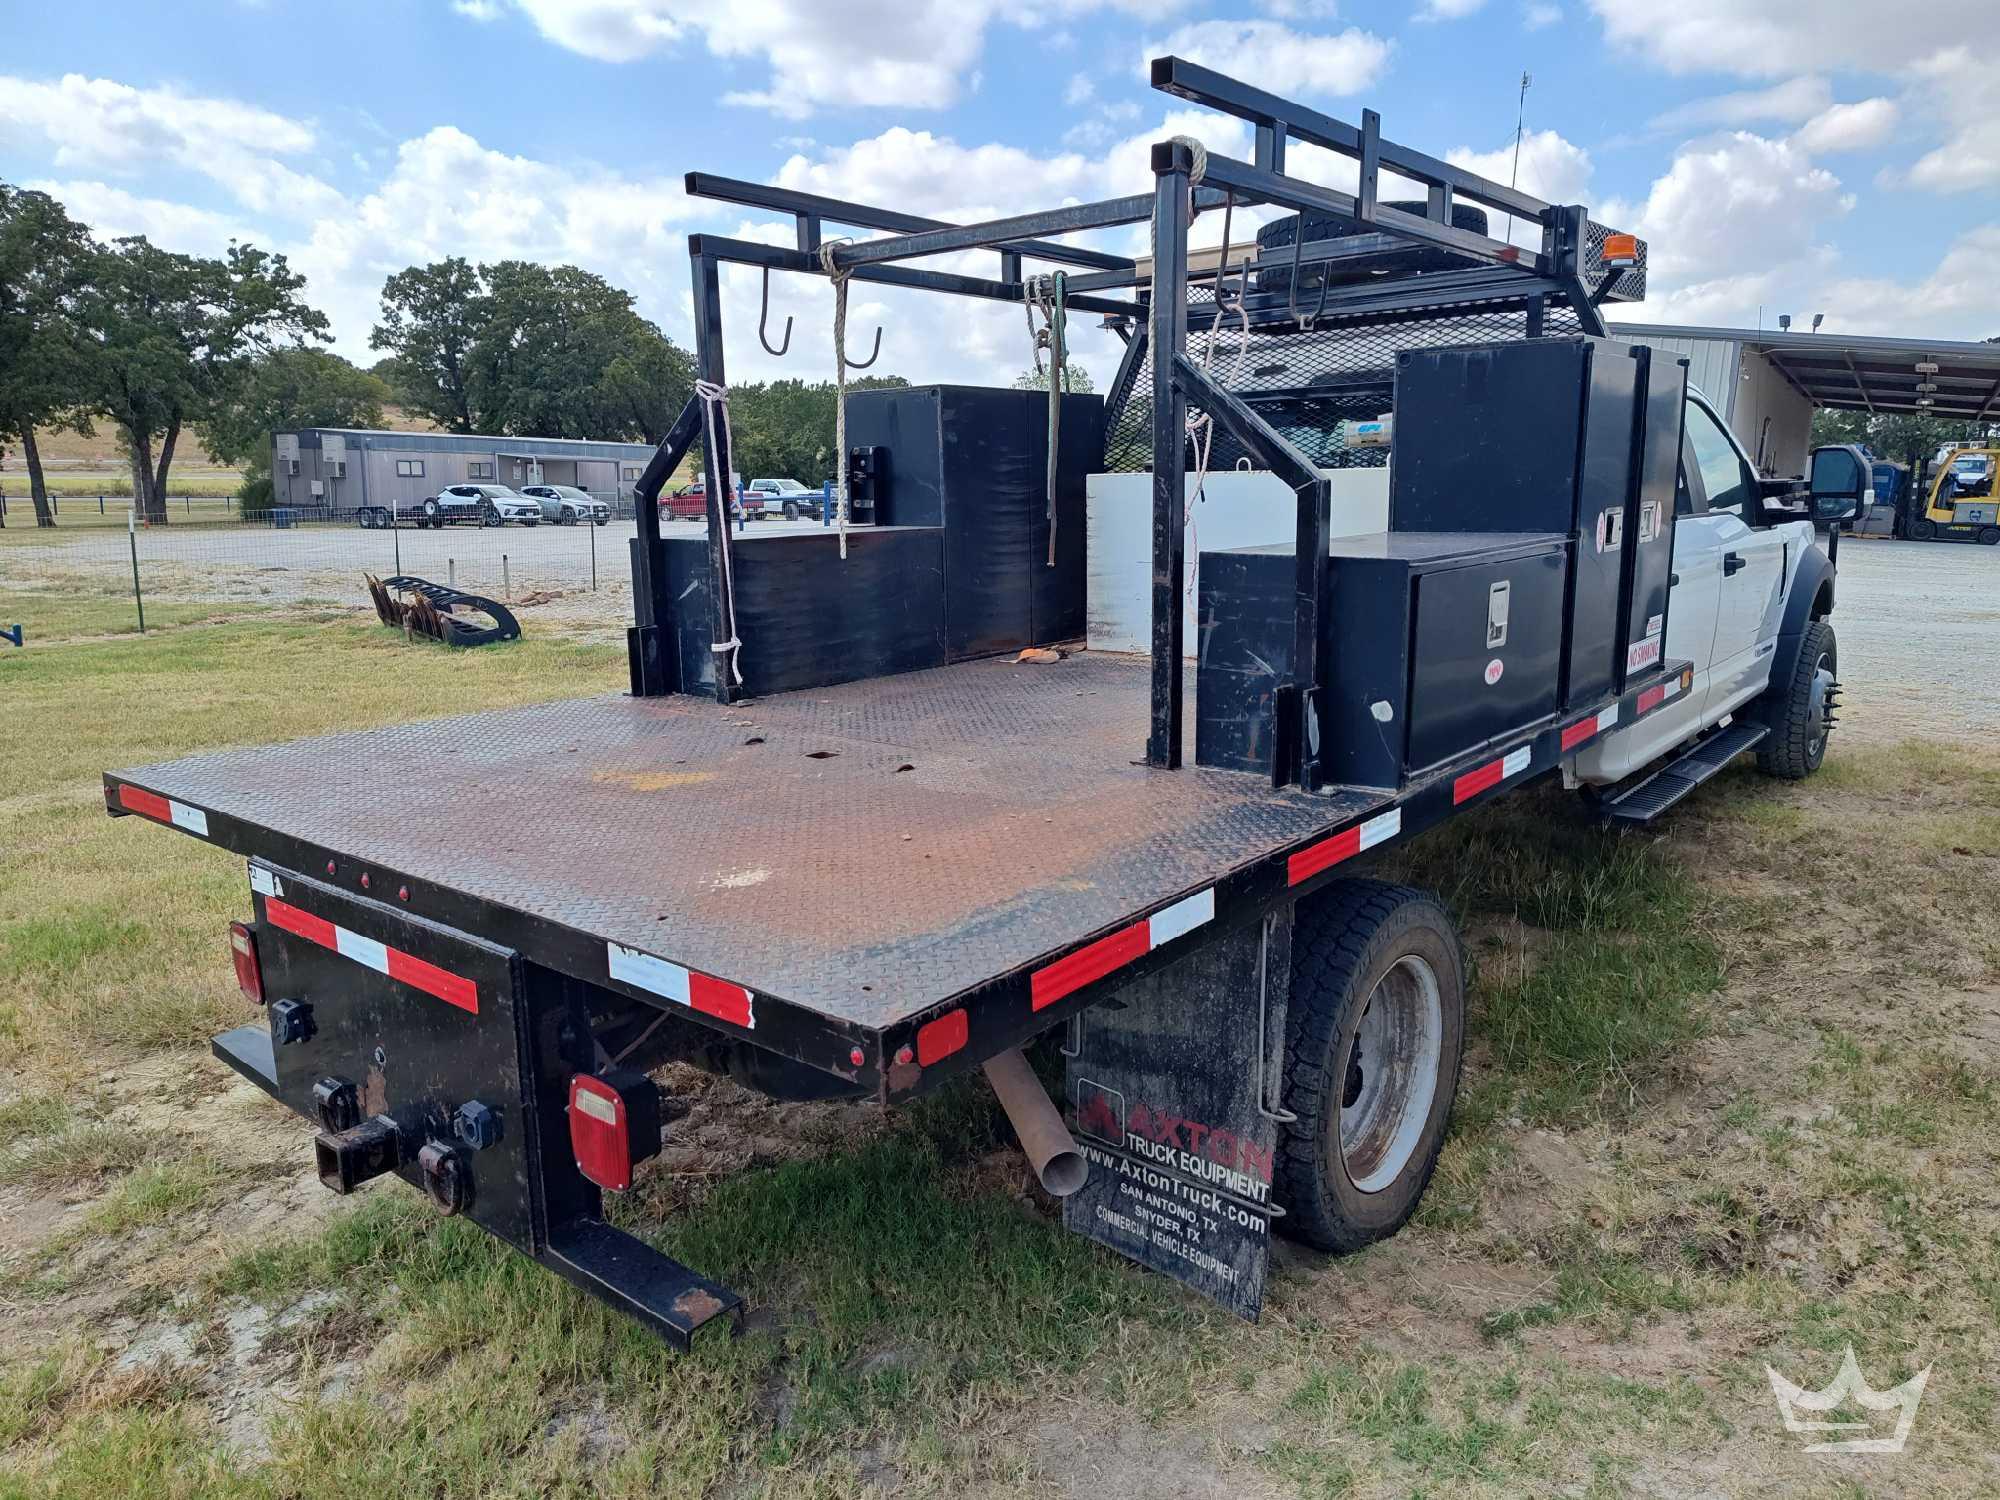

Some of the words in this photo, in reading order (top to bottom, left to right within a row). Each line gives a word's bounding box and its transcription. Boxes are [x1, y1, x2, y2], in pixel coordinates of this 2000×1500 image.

[1127, 1132, 1177, 1167] TRUCK
[1180, 1152, 1269, 1202] EQUIPMENT
[1129, 1103, 1272, 1183] AXTON
[1120, 1183, 1143, 1201] SAN
[1145, 1194, 1199, 1225] ANTONIO,
[1202, 1217, 1218, 1233] TX
[1134, 1205, 1184, 1237] SNYDER,
[1186, 1229, 1201, 1243] TX
[1096, 1204, 1149, 1240] COMMERCIAL
[1152, 1231, 1188, 1259] VEHICLE
[1189, 1248, 1239, 1285] EQUIPMENT
